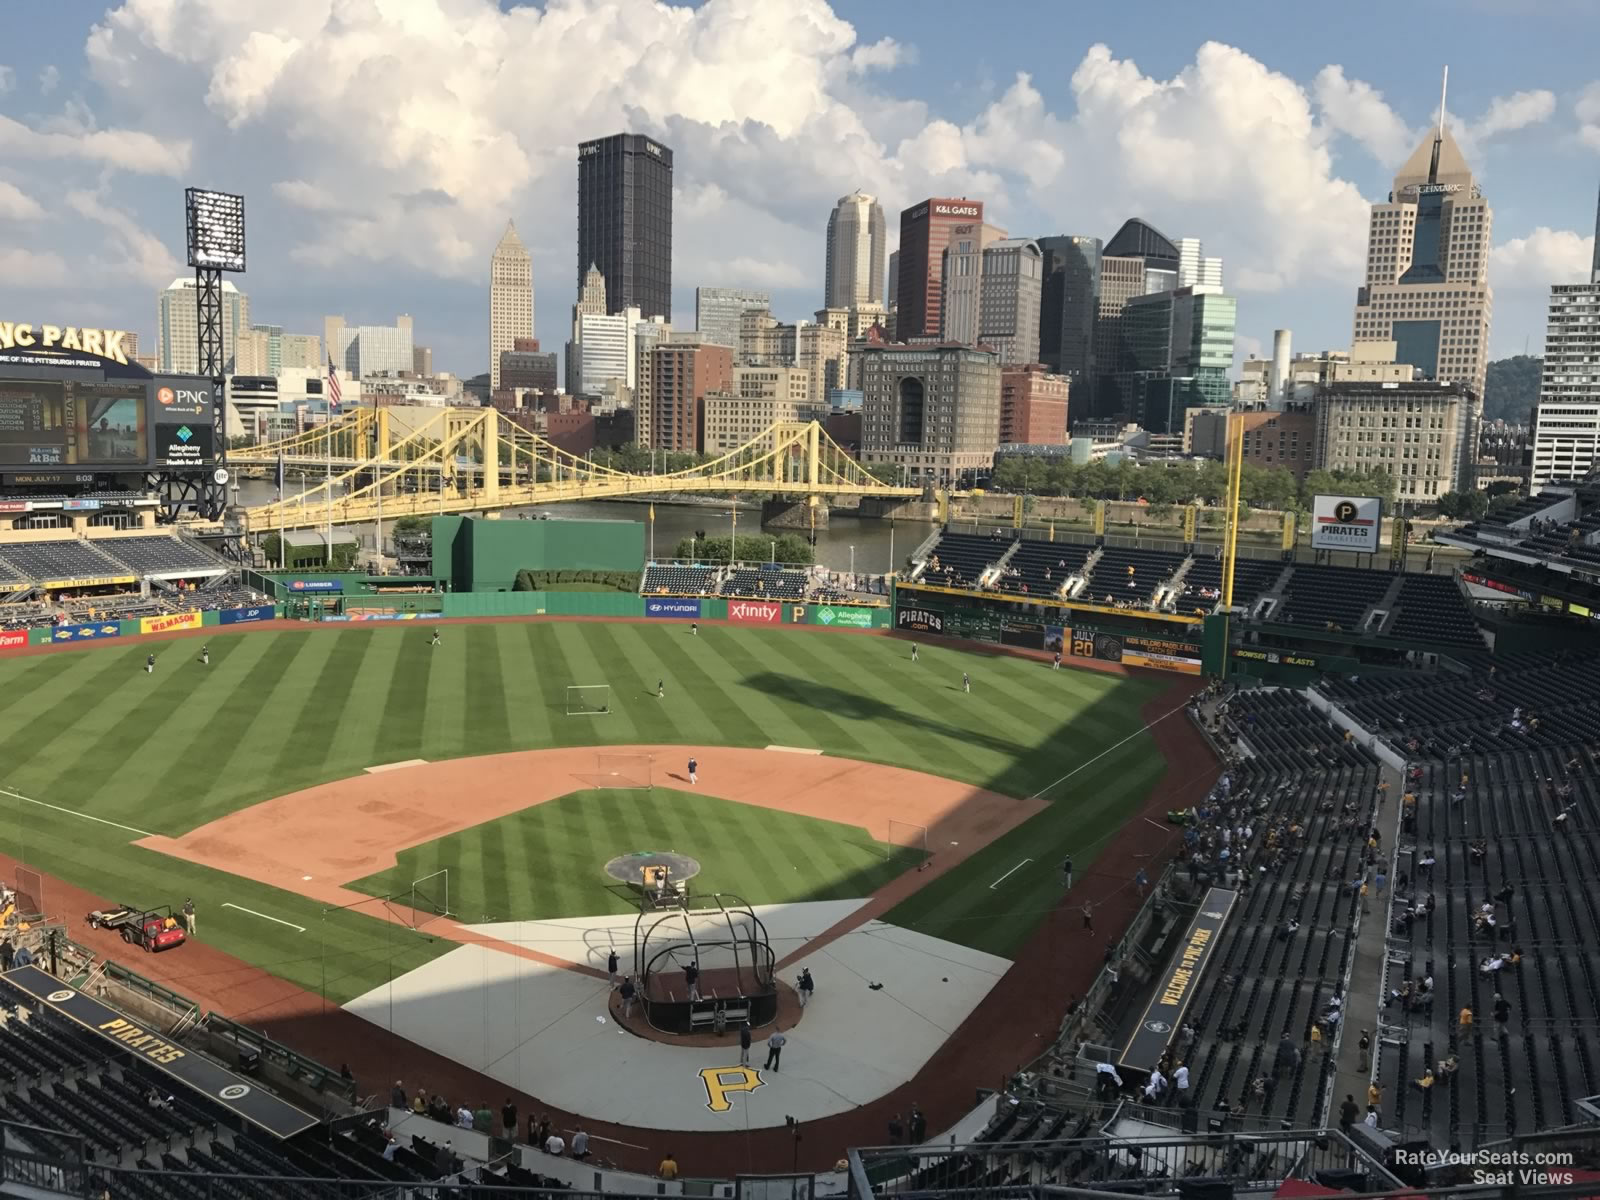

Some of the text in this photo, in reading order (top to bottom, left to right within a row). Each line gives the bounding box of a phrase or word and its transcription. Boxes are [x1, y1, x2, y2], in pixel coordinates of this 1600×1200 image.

[936, 205, 977, 215] K&L GATES
[0, 321, 128, 366] NC PARK
[35, 358, 75, 366] PITTSBURGH
[176, 390, 208, 404] PNC
[30, 454, 59, 462] At Bat
[216, 472, 228, 480] Lite
[1341, 506, 1352, 519] P
[1321, 526, 1368, 536] PIRATES
[247, 609, 259, 617] JDP
[732, 603, 777, 621] xfinity
[792, 606, 804, 622] P
[838, 611, 871, 620] Allegheny
[900, 610, 941, 630] PIRATES
[911, 623, 929, 631] .com
[0, 636, 24, 645] Farm
[1073, 631, 1095, 641] JULY
[1074, 640, 1093, 656] 20
[1140, 639, 1160, 647] VELCRO
[1162, 641, 1184, 650] PADDLE
[1238, 650, 1267, 660] BOWSER
[1287, 657, 1315, 666] BLASTS
[1160, 927, 1212, 1005] WELCOME TO PNC PARK
[99, 1018, 185, 1063] PIRATES
[697, 1065, 768, 1112] P
